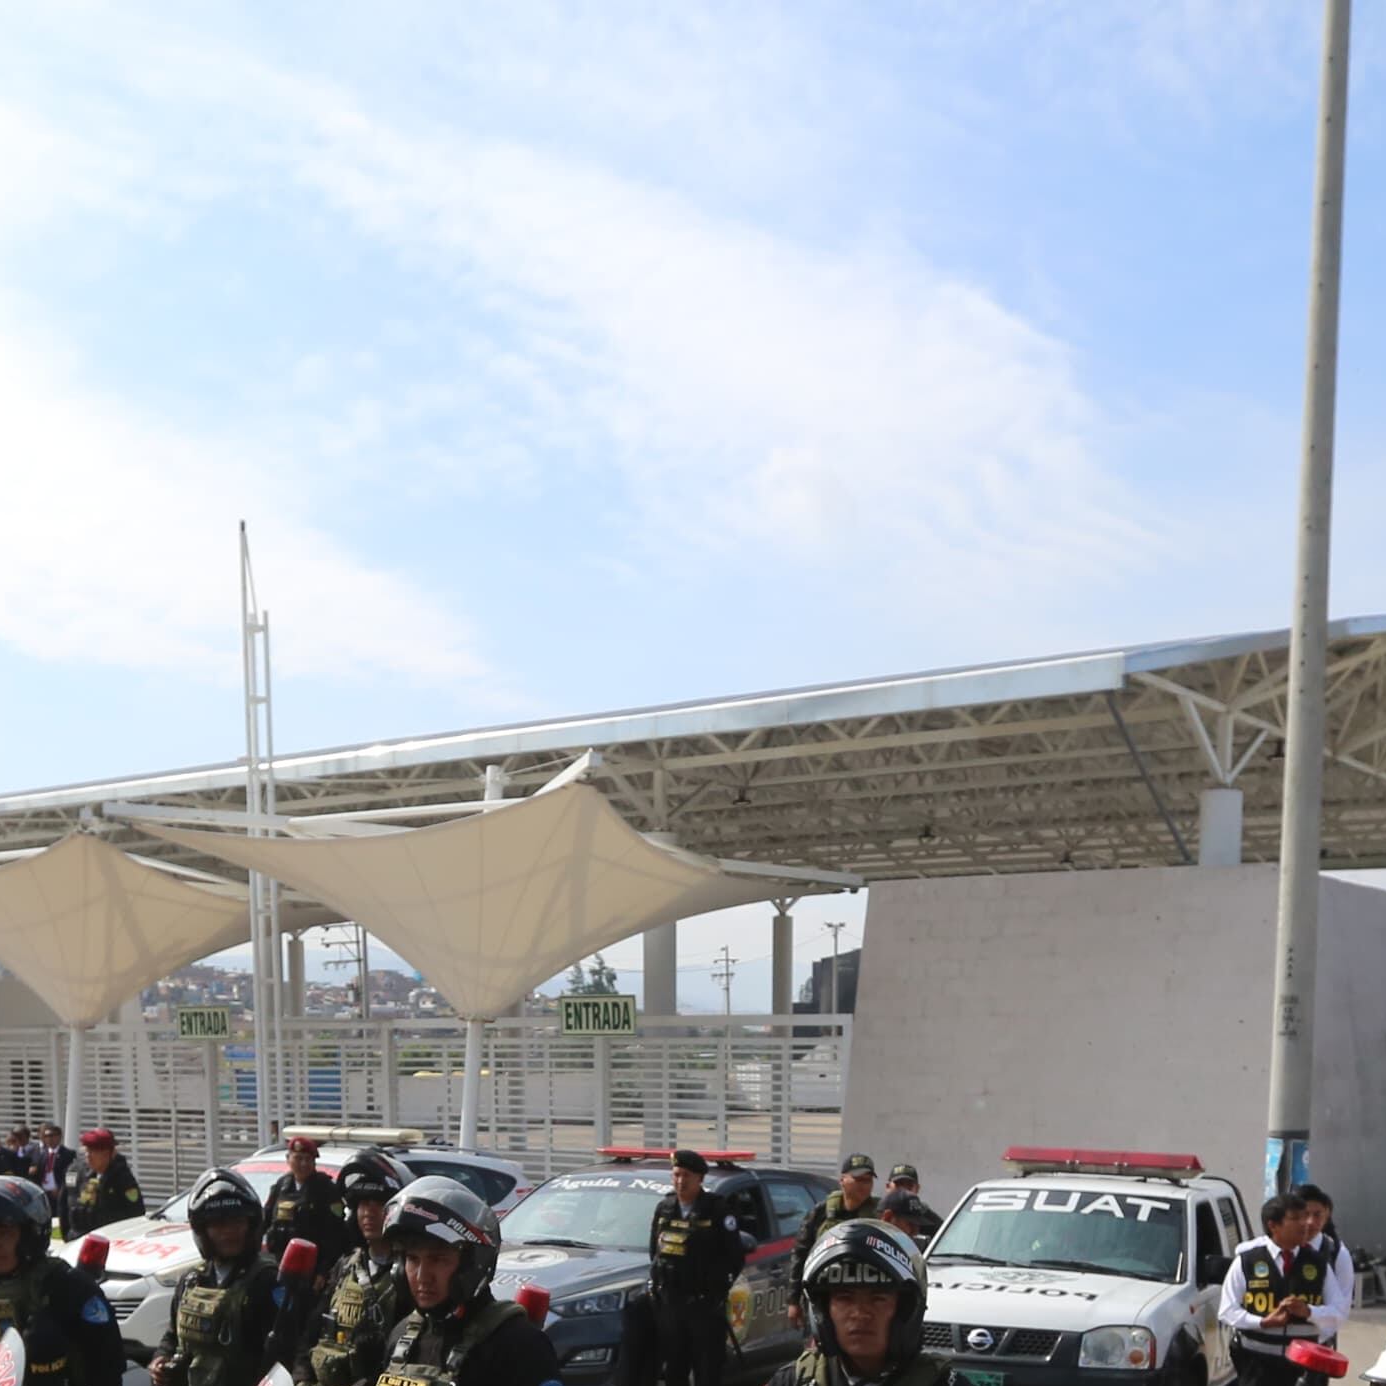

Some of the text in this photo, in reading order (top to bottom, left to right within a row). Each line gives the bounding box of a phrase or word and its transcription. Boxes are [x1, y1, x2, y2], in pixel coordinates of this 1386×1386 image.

[180, 1011, 228, 1035] ENTRADA
[565, 1002, 632, 1030] ENTRADA
[970, 1190, 1171, 1222] SUAT
